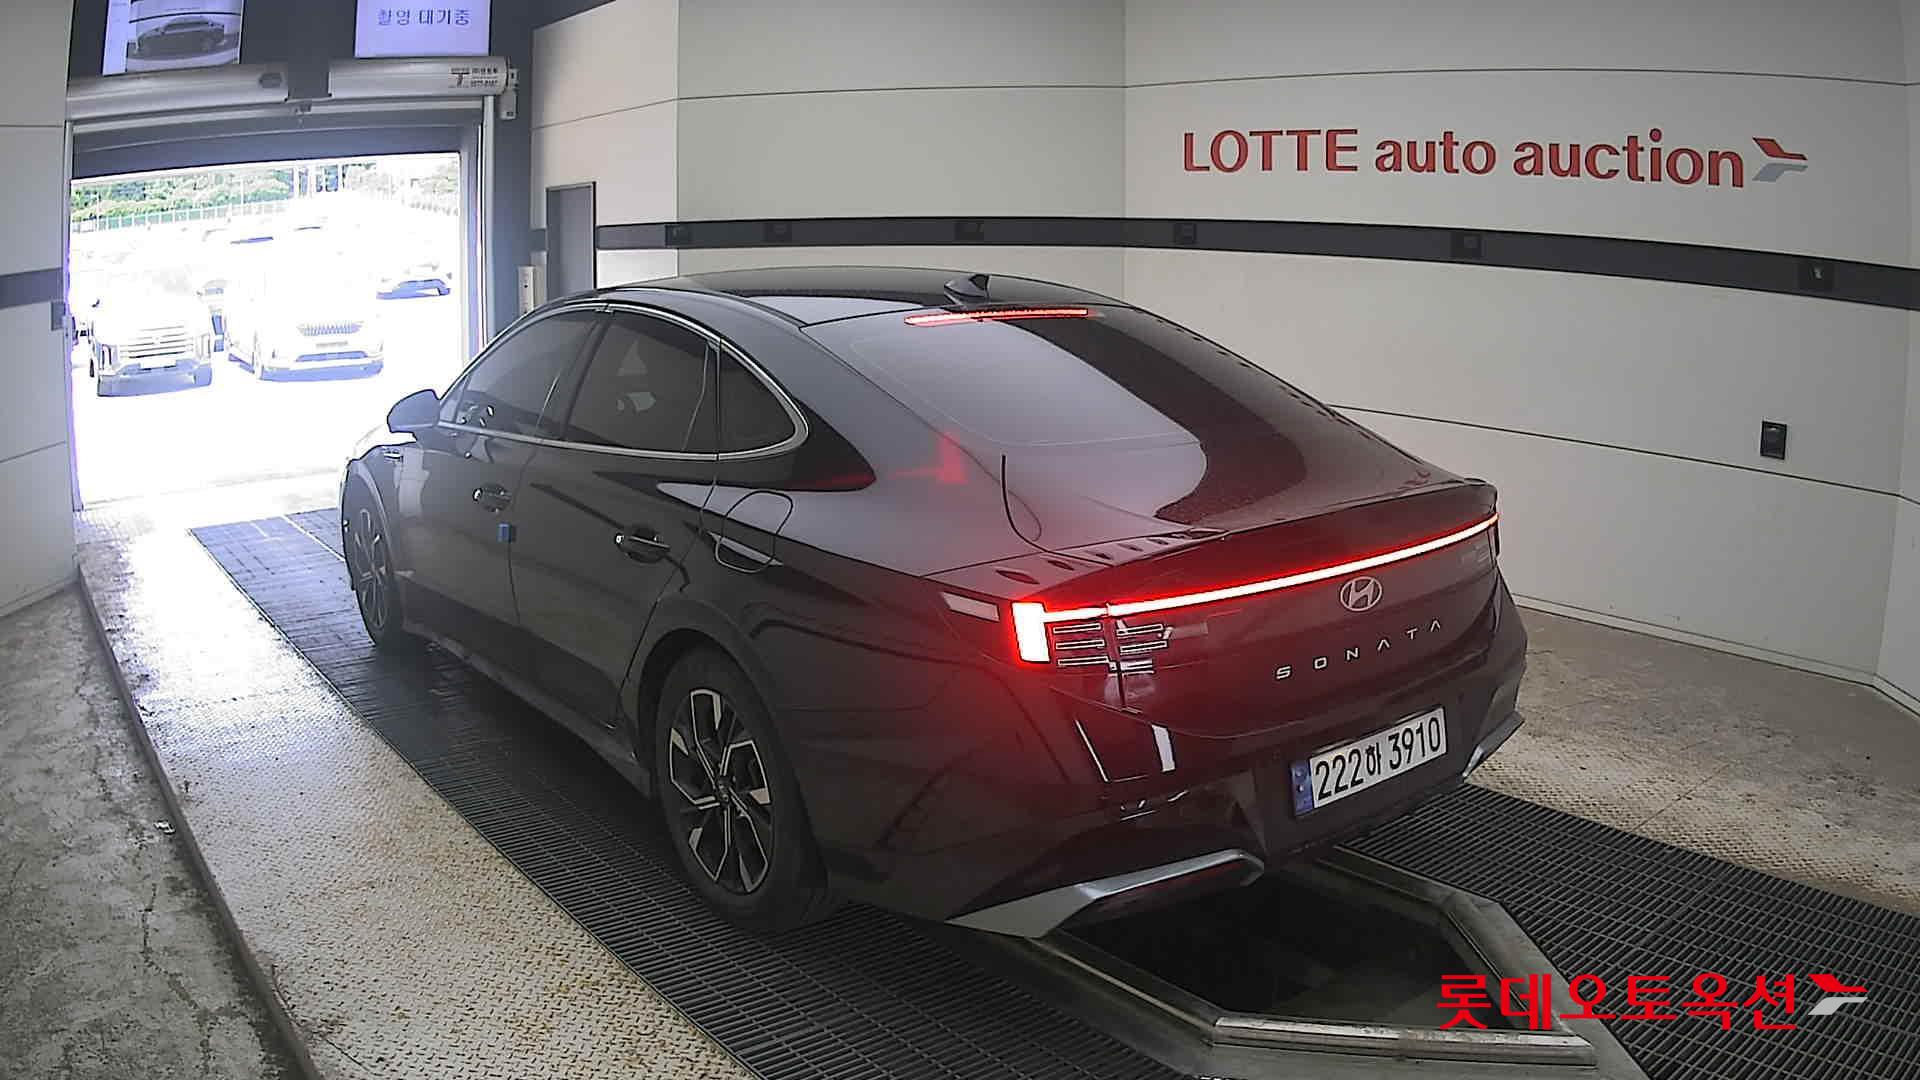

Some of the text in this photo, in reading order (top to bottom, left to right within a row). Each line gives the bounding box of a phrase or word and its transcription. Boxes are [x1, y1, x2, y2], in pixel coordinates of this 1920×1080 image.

[418, 9, 471, 26] 대기중
[1183, 128, 1744, 188] LOTTE auto auction
[1275, 619, 1441, 680] SONATA
[1315, 716, 1441, 800] 222하 3910
